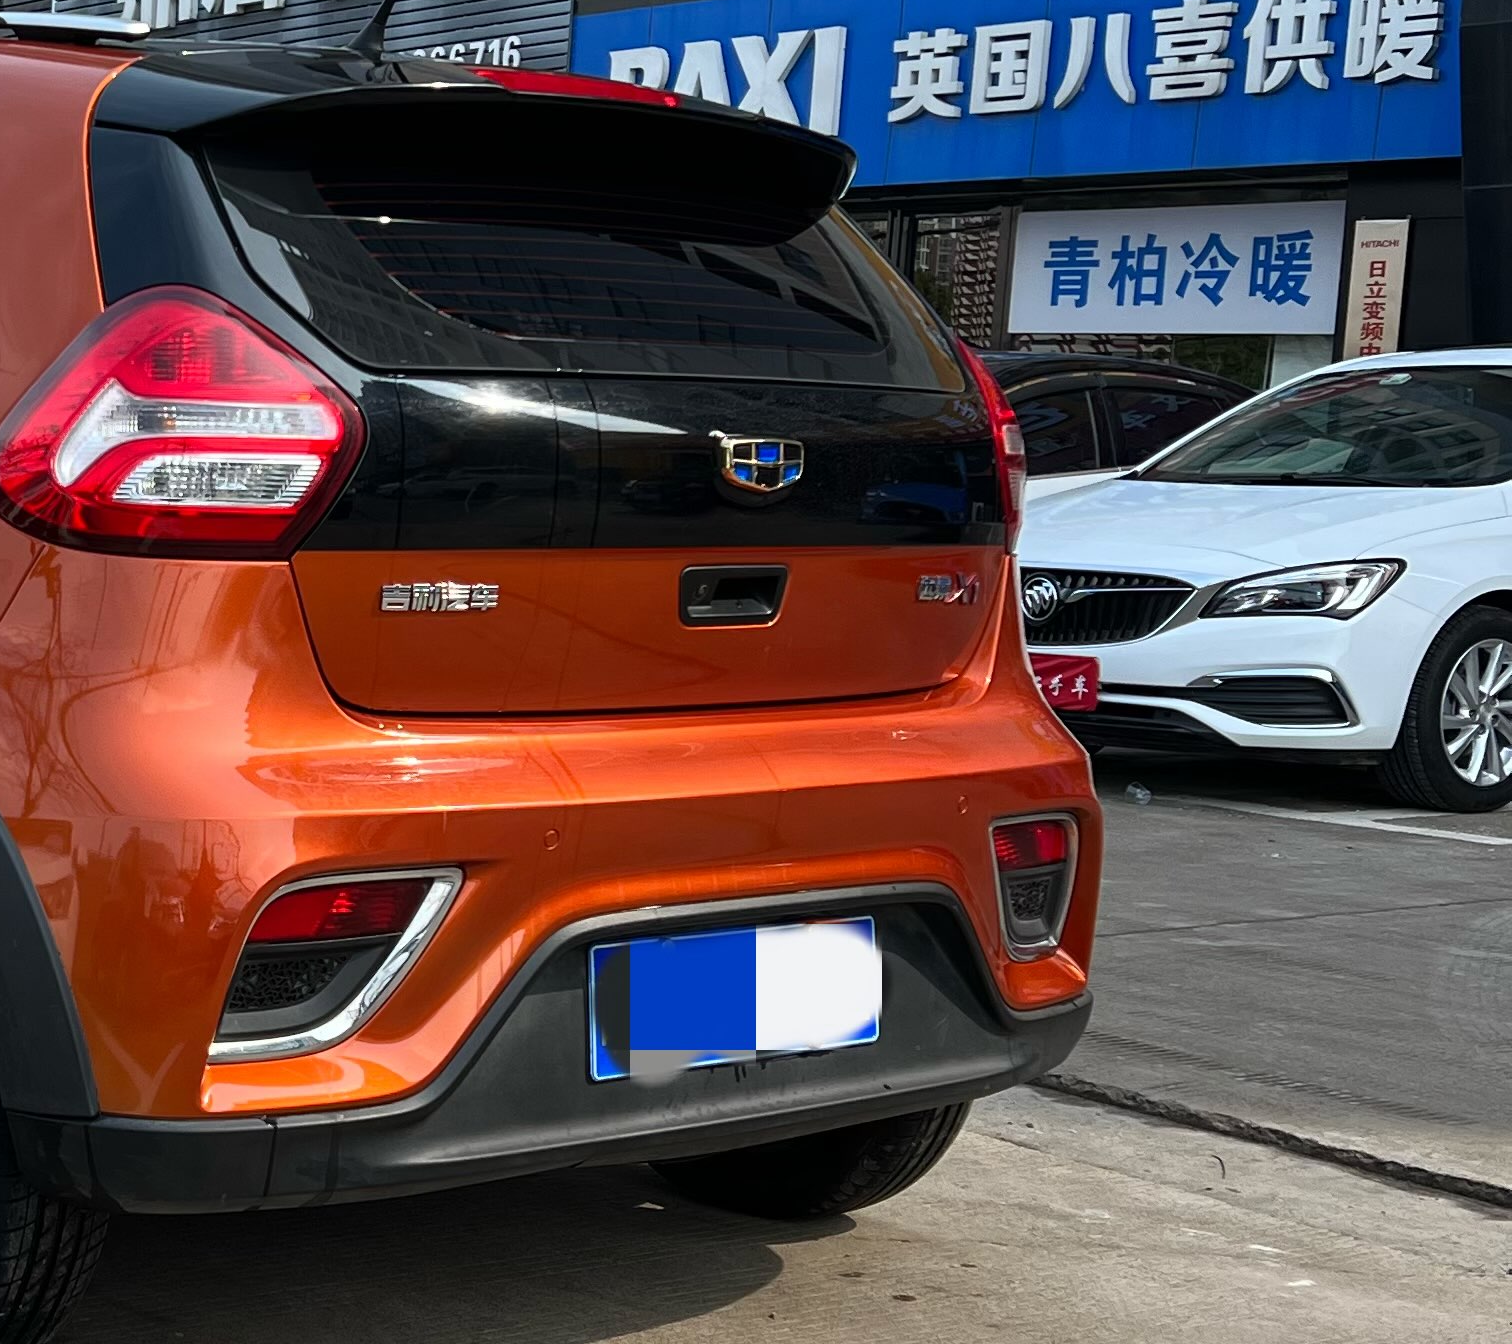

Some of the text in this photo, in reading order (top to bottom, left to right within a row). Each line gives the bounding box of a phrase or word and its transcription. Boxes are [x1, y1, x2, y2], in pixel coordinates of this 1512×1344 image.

[1360, 239, 1400, 249] HITACHI
[1044, 229, 1315, 309] 青柏冷暖
[381, 581, 500, 612] 吉利汽车
